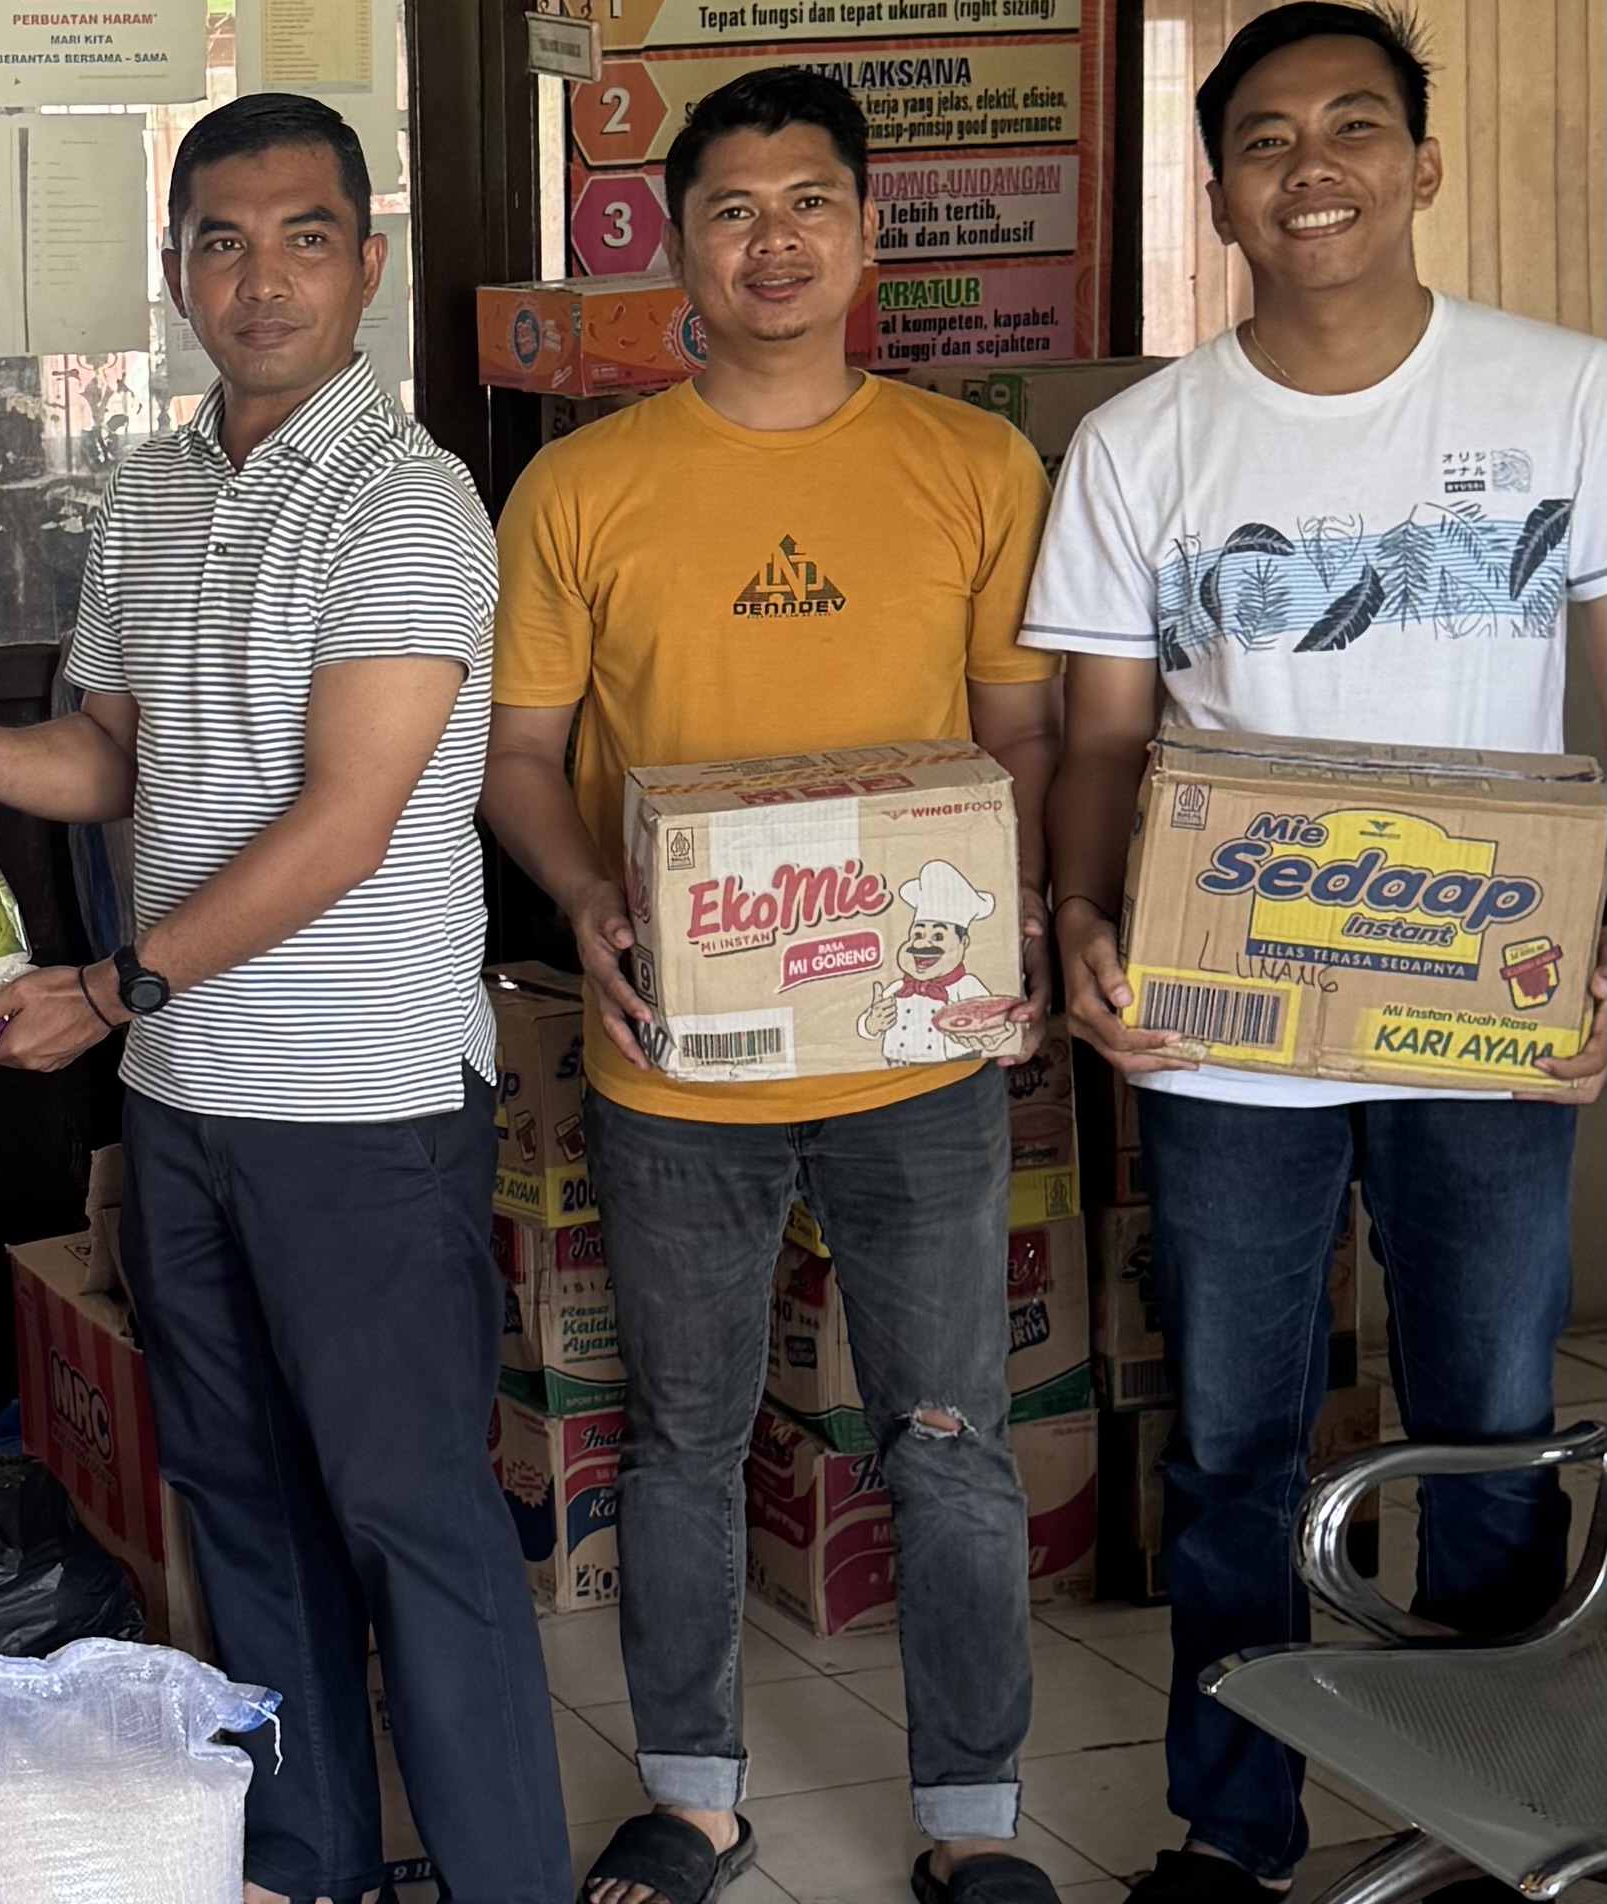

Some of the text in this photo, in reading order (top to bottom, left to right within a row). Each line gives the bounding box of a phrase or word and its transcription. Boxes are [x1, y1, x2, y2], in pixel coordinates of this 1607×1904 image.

[12, 14, 98, 25] PERBUATAN
[699, 6, 746, 29] Tepat
[751, 2, 804, 28] fungsi
[808, 3, 836, 23] dan
[839, 2, 883, 25] tepat
[888, 0, 948, 20] ukuran
[50, 34, 113, 45] MARI KITA
[64, 53, 122, 63] BERSAMA
[134, 53, 168, 63] SAMA
[784, 58, 971, 89] TALAKSANA
[602, 86, 630, 133] 2
[602, 203, 633, 248] 3
[890, 199, 1002, 225] lebih tertib,
[915, 221, 1035, 247] dan kondusif
[901, 314, 988, 336] kompeten,
[888, 335, 1050, 362] tinggi dan sejahtera
[1249, 815, 1326, 844] Mie
[1199, 842, 1540, 930] Sedaap
[719, 932, 771, 951] INSTAN
[1344, 915, 1457, 946] Instant
[788, 945, 879, 977] MI GORENG
[1259, 943, 1466, 978] JELAS TERASA SEDAPNYA
[1406, 1006, 1539, 1032] Instan Kuah Rasa
[1374, 1024, 1555, 1067] KARI AYAM
